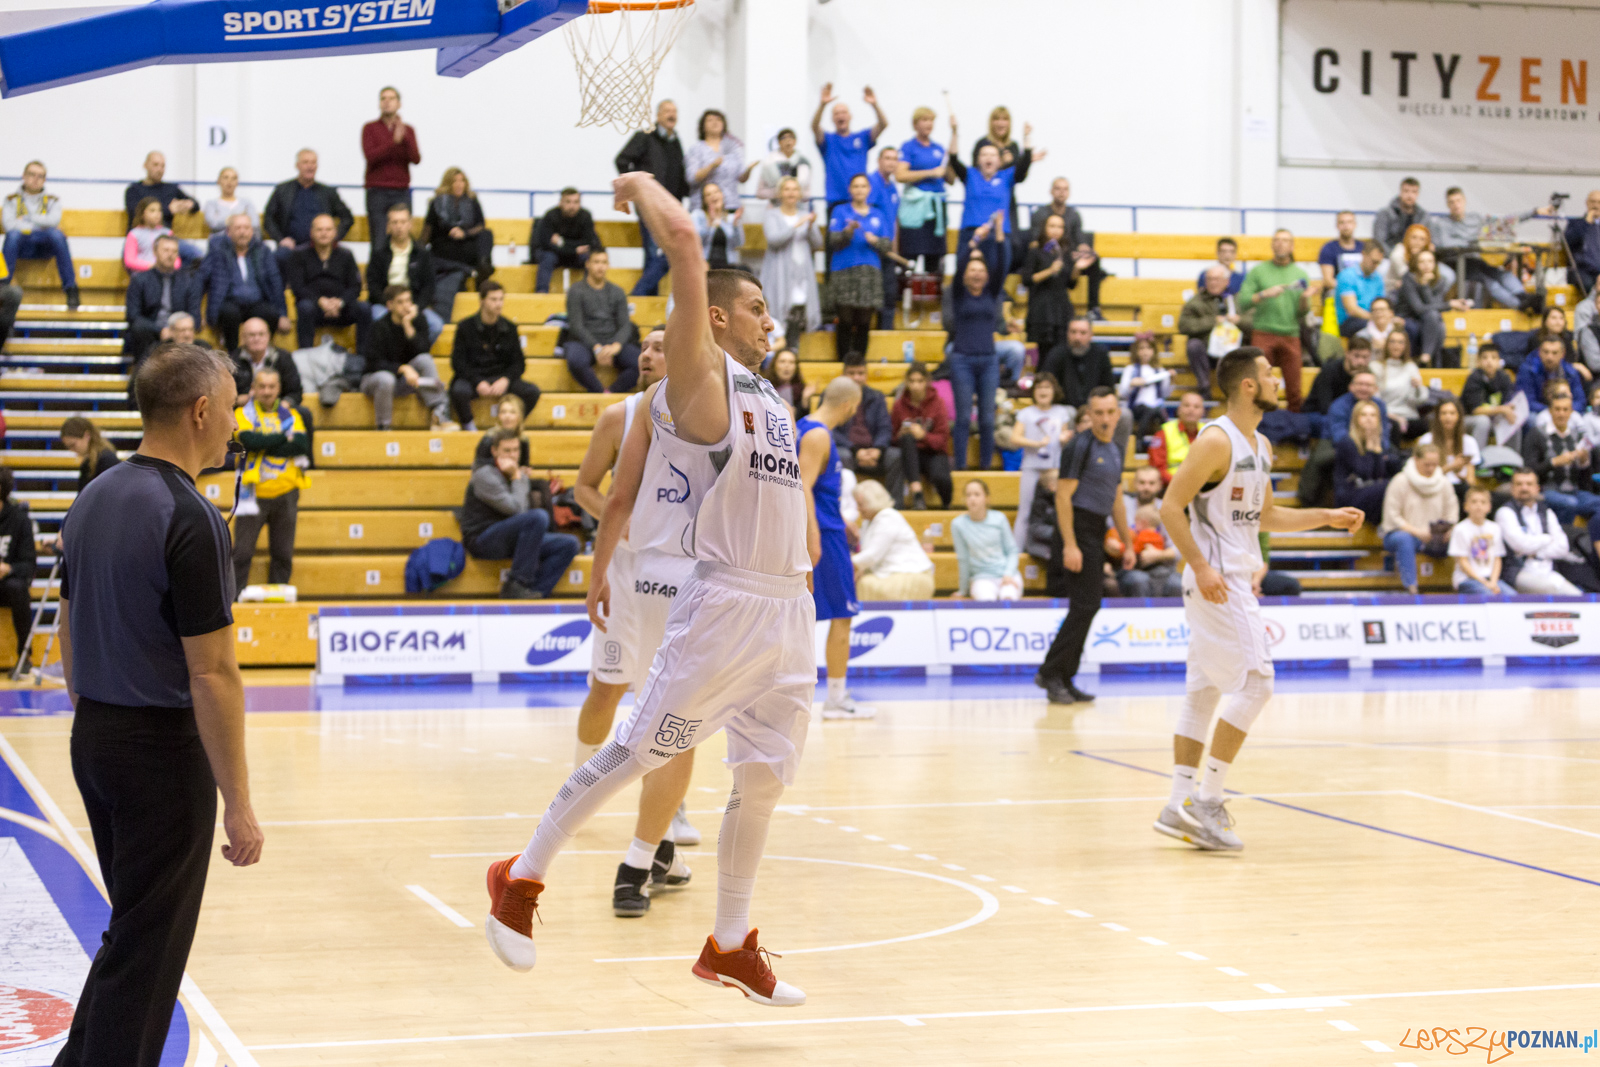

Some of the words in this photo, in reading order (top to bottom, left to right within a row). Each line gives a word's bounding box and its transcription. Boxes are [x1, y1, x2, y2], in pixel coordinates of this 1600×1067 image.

[223, 7, 319, 33] SPORT
[322, 0, 435, 30] SYSTEM
[1313, 48, 1588, 105] CITYZEN
[1478, 105, 1512, 119] KLUB
[1518, 107, 1588, 121] SPORTOWY
[209, 126, 227, 146] D
[330, 630, 466, 652] BIOFARM
[1396, 621, 1485, 642] NICKEL
[605, 641, 621, 665] 9
[655, 713, 702, 749] 55
